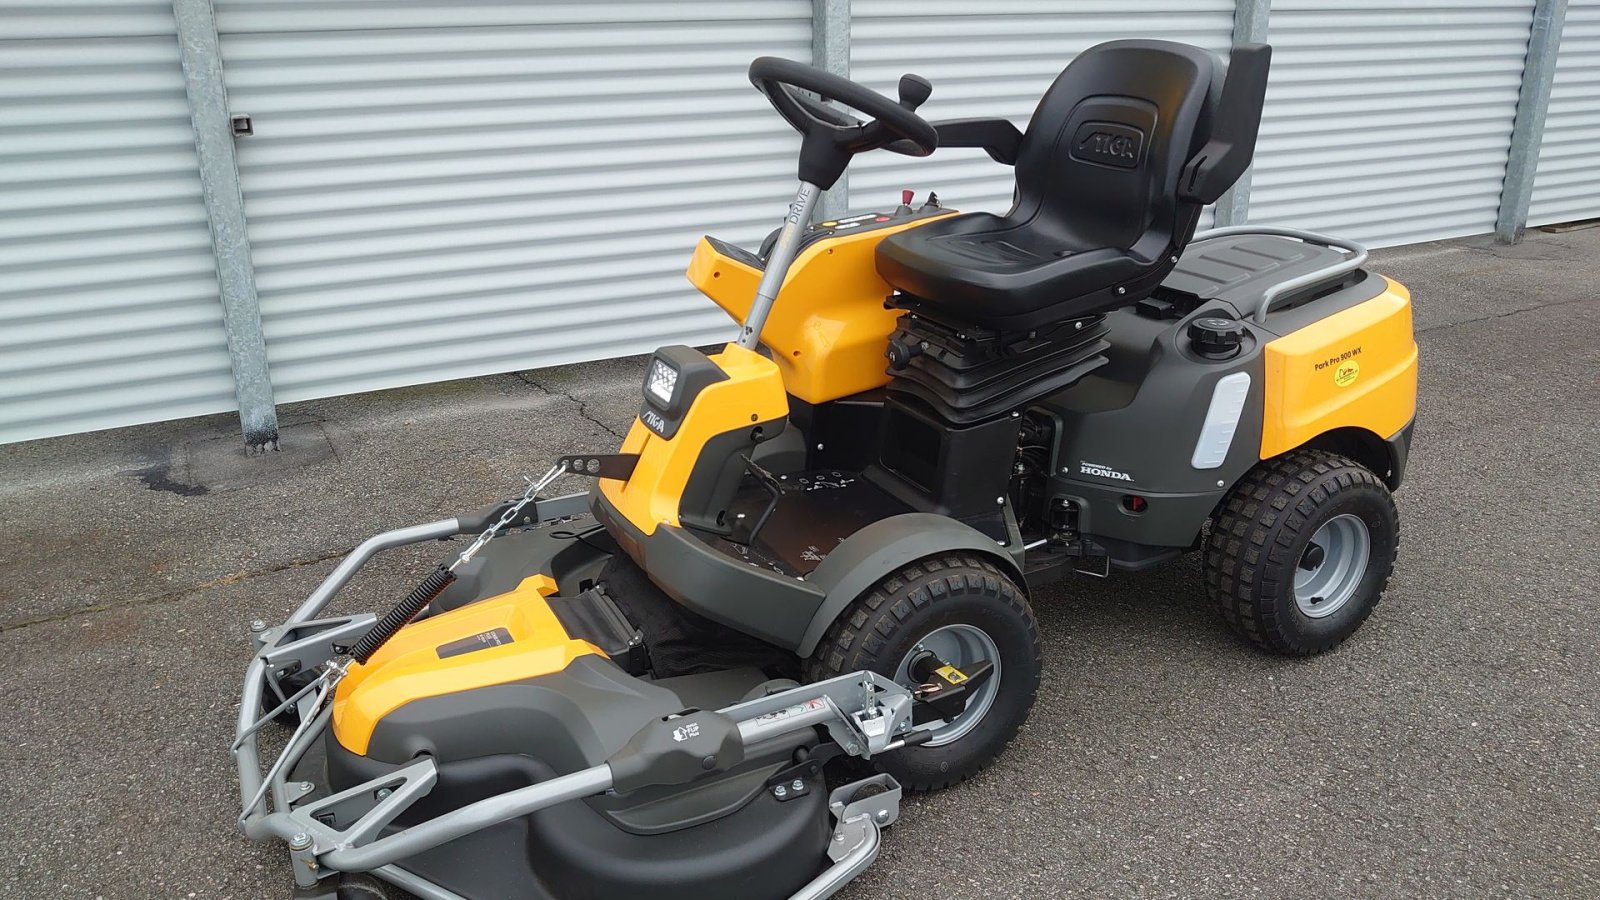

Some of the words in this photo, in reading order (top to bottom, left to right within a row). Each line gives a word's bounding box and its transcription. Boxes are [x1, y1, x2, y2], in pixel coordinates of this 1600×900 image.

[1079, 131, 1133, 158] STIGA
[789, 188, 810, 225] DRIVE
[1314, 360, 1329, 371] Park
[1330, 357, 1340, 365] Pro
[1352, 346, 1361, 356] WX
[642, 410, 665, 433] STIGA
[1080, 466, 1132, 481] HONDA
